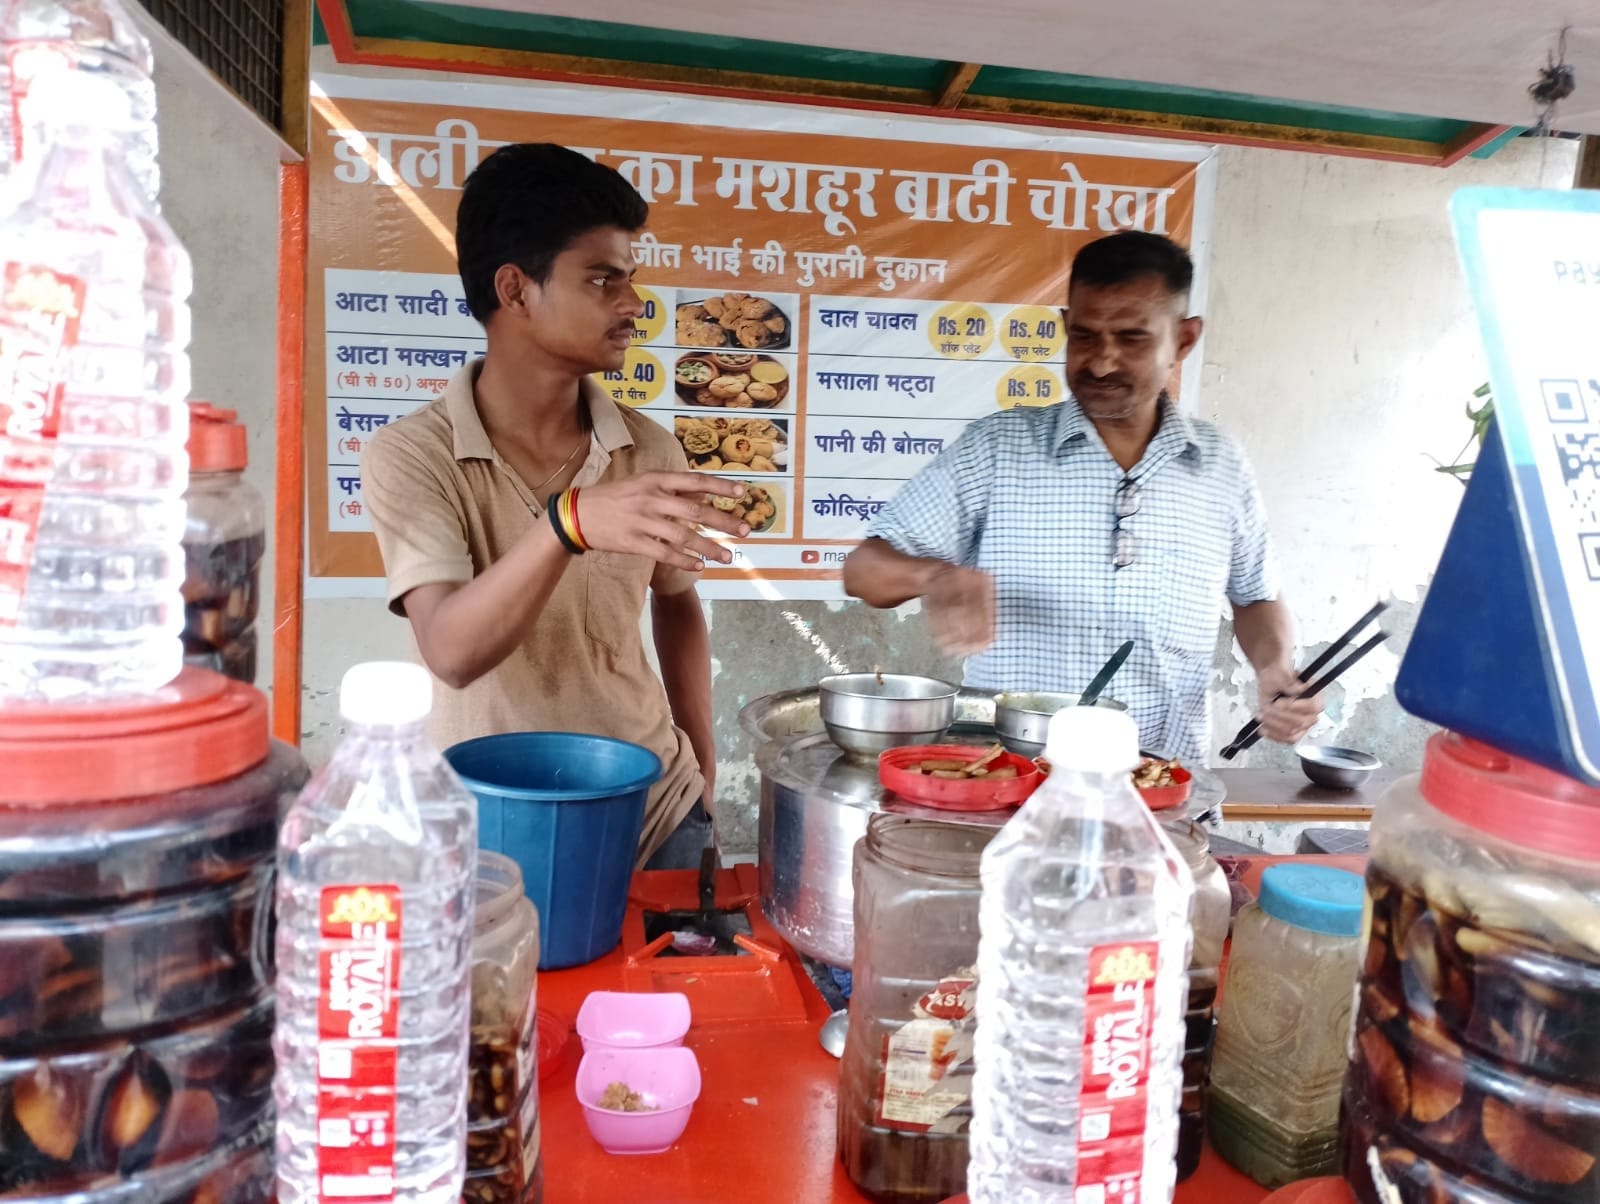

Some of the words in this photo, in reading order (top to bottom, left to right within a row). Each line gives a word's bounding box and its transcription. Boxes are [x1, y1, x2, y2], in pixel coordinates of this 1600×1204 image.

[609, 149, 703, 206] का
[712, 157, 884, 236] मशहूर
[890, 159, 1017, 227] बाटी
[1027, 162, 1175, 236] चोखा
[691, 238, 743, 277] भाई
[749, 240, 786, 275] की
[794, 244, 866, 287] पुरानी
[874, 256, 948, 291] दुकान
[335, 292, 388, 313] आटा
[395, 289, 448, 316] सादी
[818, 309, 859, 328] दाल
[865, 311, 918, 331] चावल
[937, 316, 961, 336] Rs.
[966, 317, 986, 337] 20
[1009, 319, 1032, 338] Rs.
[1036, 320, 1056, 339] 40
[336, 345, 388, 366] आटा
[395, 347, 467, 368] मक्खन
[1011, 346, 1029, 359] फुल
[1032, 345, 1050, 356] प्लेट
[634, 363, 655, 382] 40
[816, 372, 880, 391] मसाला
[611, 387, 623, 399] दो
[627, 387, 646, 400] पीस
[1007, 378, 1030, 397] Rs.
[1035, 379, 1051, 397] 15
[814, 429, 856, 453] पानी
[860, 430, 887, 454] की
[892, 431, 944, 455] बोतल
[348, 921, 387, 1038] ROYALE
[1106, 979, 1145, 1099] ROYALE
